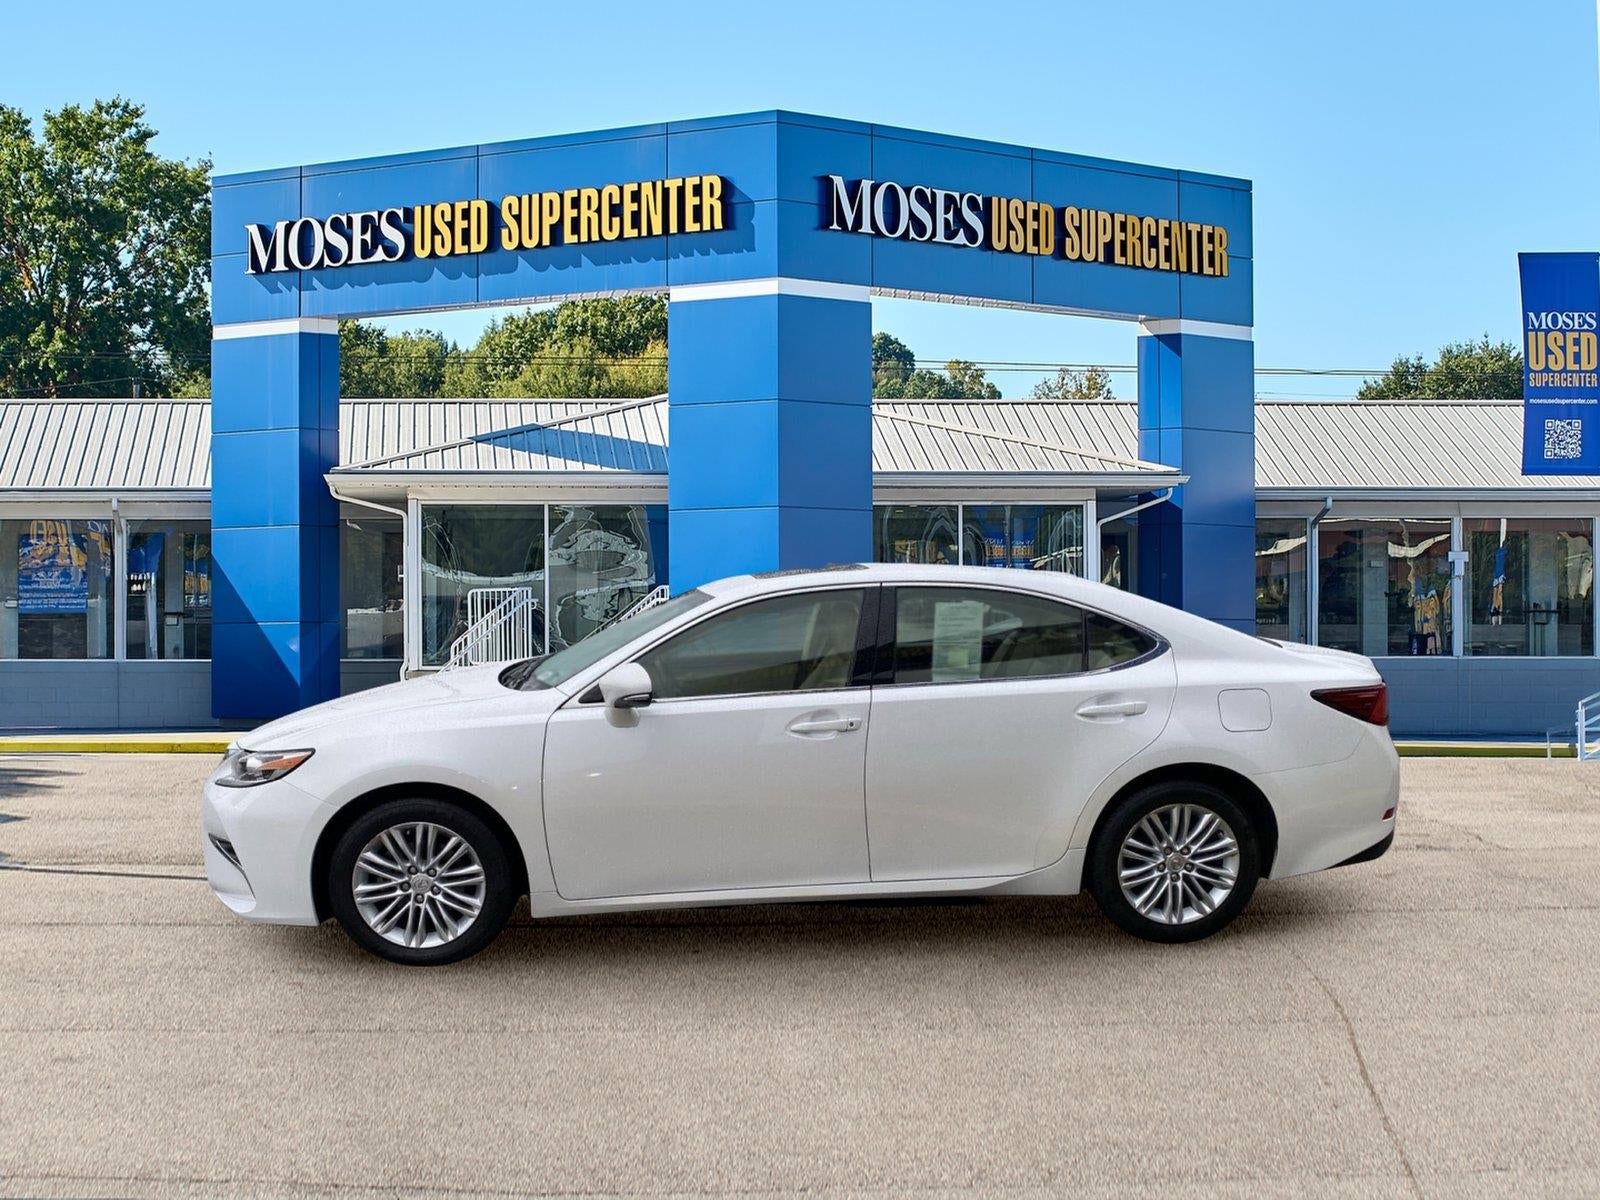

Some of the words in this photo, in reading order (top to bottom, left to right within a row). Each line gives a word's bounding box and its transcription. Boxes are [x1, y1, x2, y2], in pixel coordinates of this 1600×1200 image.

[244, 207, 408, 275] MOSES
[413, 199, 488, 258] USED
[501, 174, 723, 251] SUPERCENTER
[828, 174, 984, 248] MOSES
[991, 196, 1055, 256] USED
[1065, 206, 1229, 277] SUPERCENTER
[1528, 312, 1597, 329] MOSES
[1529, 332, 1598, 370] USED
[1530, 373, 1598, 387] SUPERCENTER
[1529, 397, 1598, 405] mosesusedsupercenter.com
